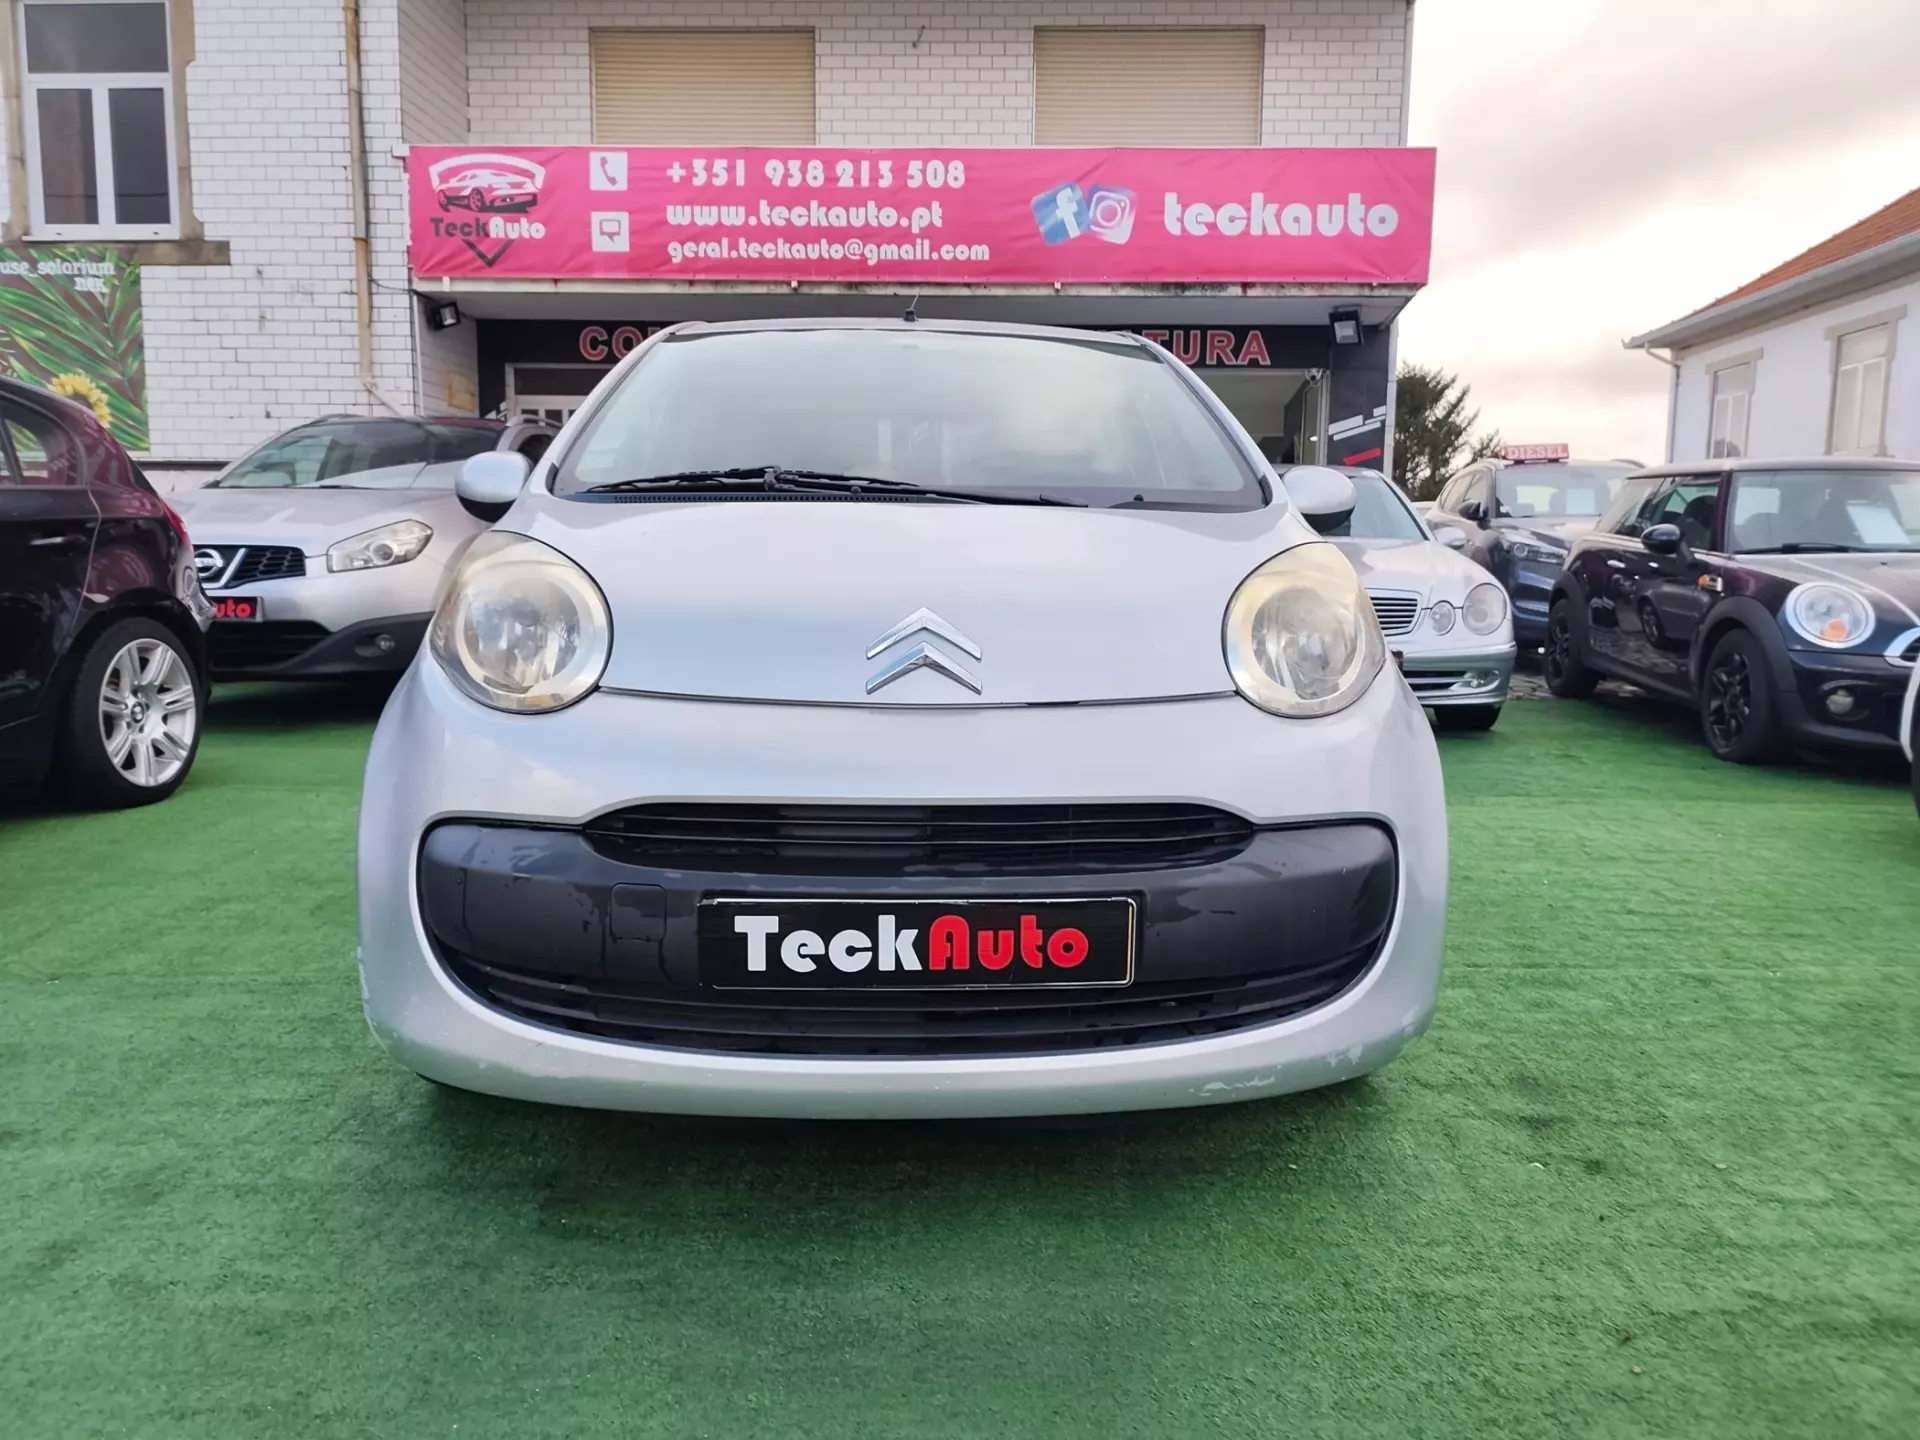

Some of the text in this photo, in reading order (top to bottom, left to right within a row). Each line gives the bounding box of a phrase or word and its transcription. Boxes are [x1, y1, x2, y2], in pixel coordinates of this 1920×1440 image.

[666, 159, 966, 188] +351 938 213 508
[430, 216, 546, 239] TeckAuto
[666, 200, 943, 234] www.teckauto.pt
[1164, 192, 1399, 237] teckauto
[667, 238, 990, 264] geral.teckauto@gmail.com
[579, 326, 661, 361] CO
[1120, 329, 1271, 365] TURA
[1507, 445, 1567, 460] DIESEL
[215, 597, 252, 618] uto
[734, 914, 1089, 973] TeckAuto
